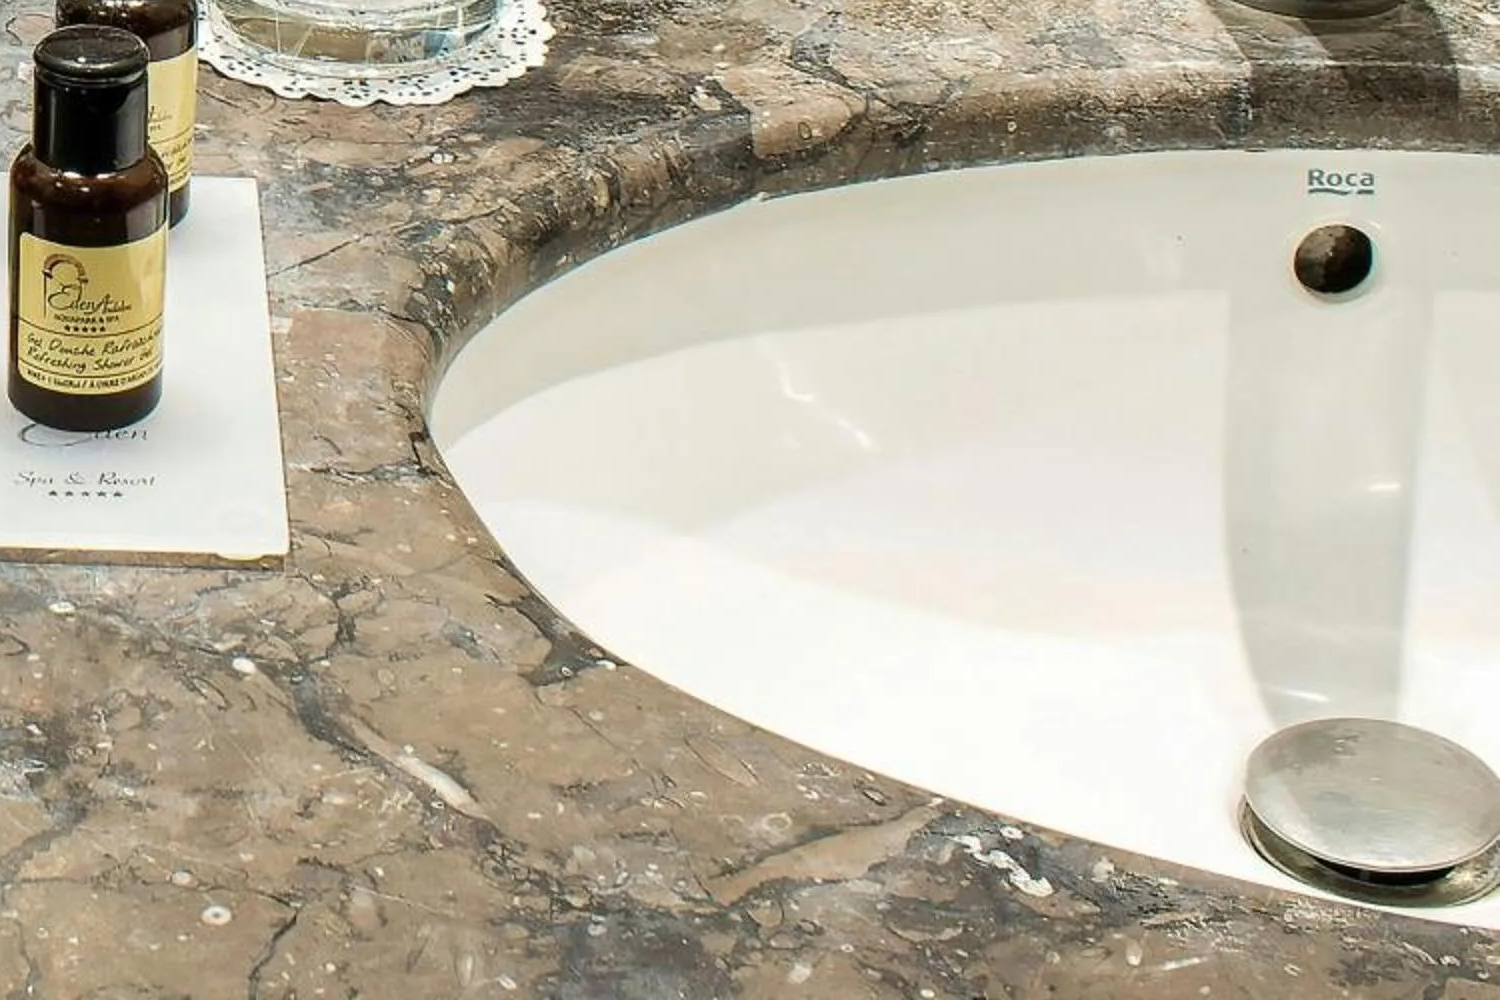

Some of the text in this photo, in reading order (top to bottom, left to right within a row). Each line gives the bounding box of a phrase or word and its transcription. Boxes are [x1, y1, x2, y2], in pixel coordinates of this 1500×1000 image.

[1308, 168, 1375, 195] Roca
[27, 346, 87, 374] Refreshing
[93, 356, 135, 371] Shower
[14, 471, 157, 487] Spa & Resort
